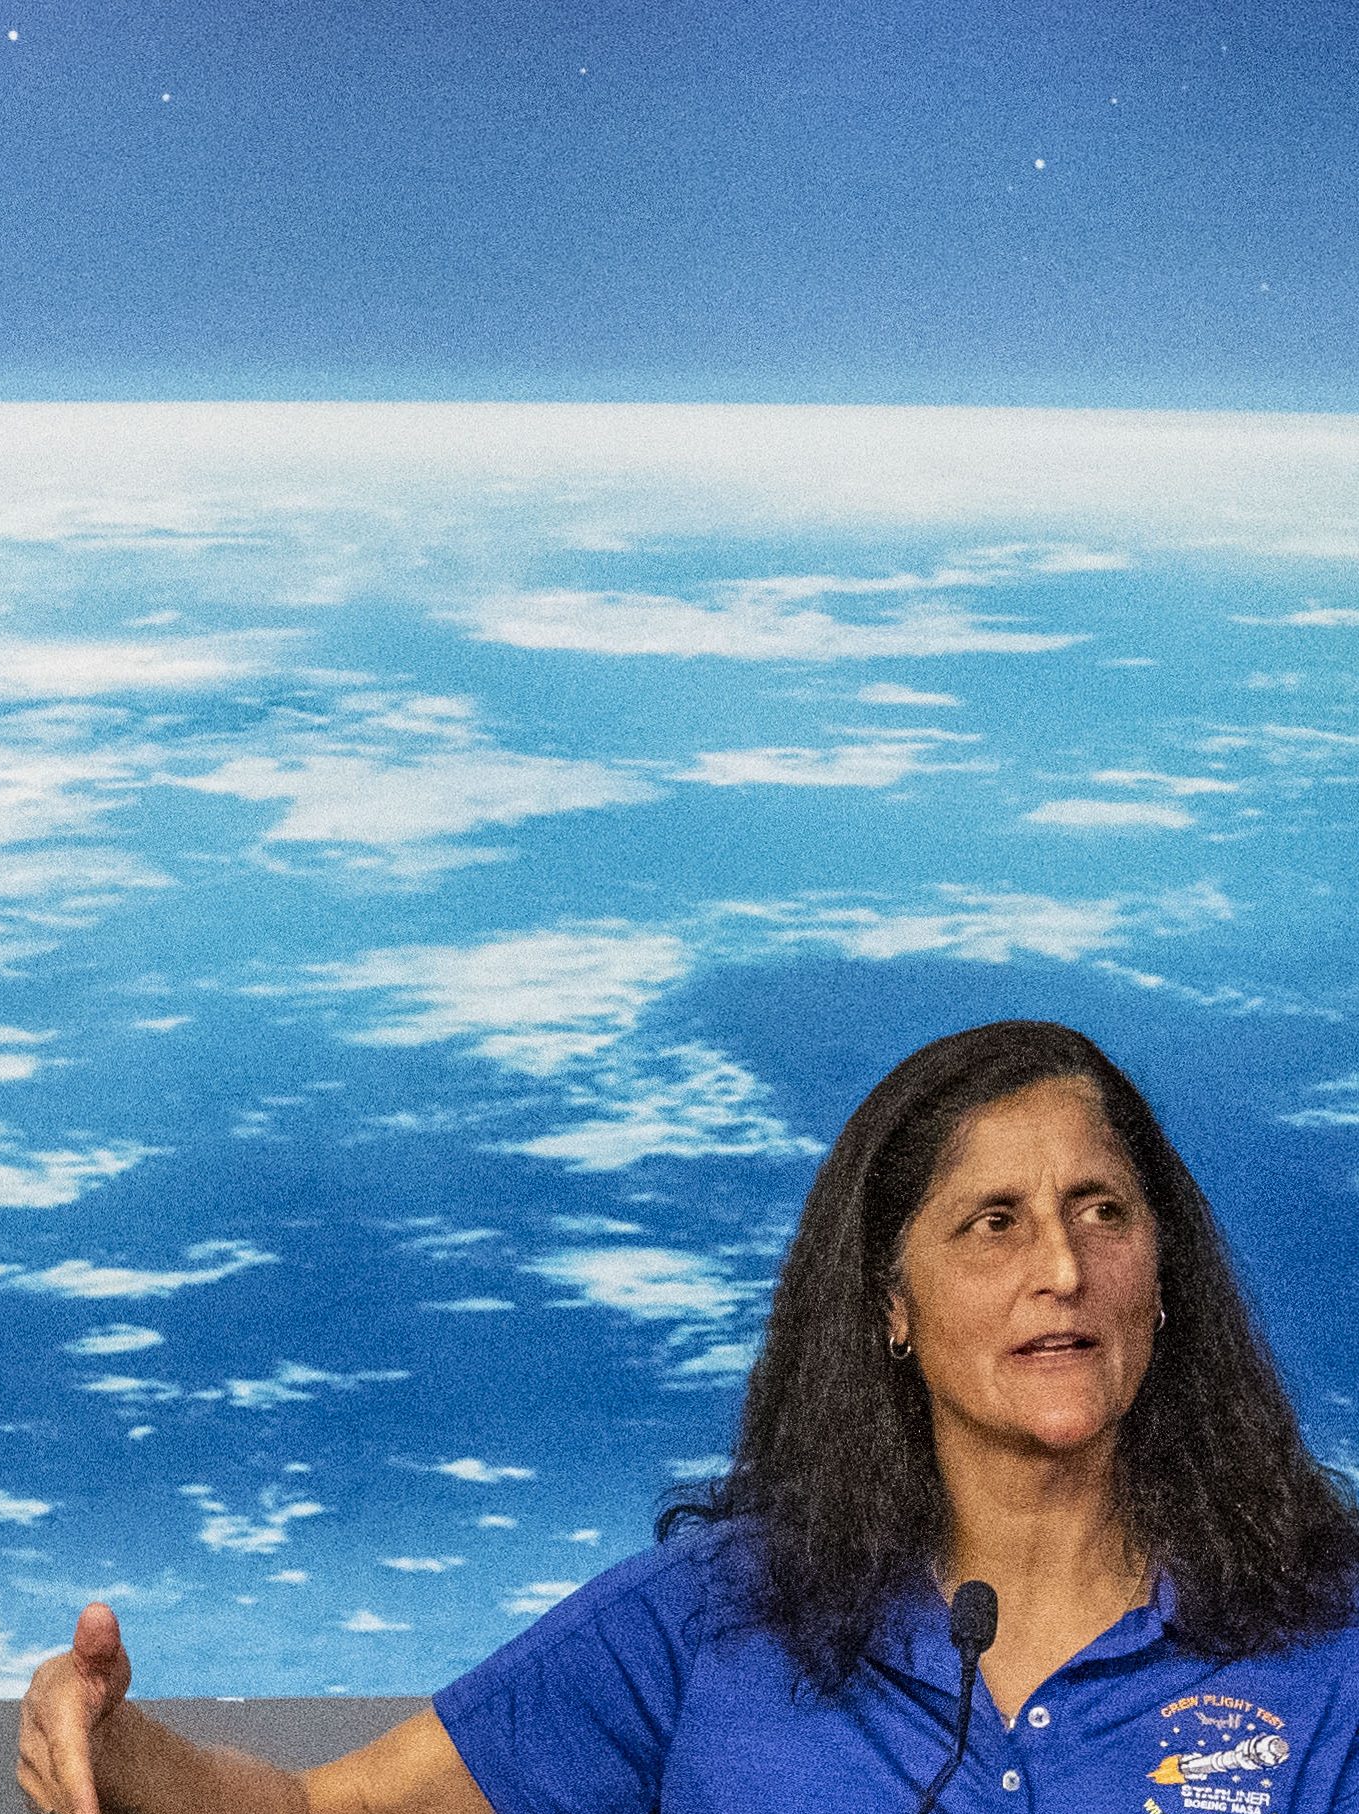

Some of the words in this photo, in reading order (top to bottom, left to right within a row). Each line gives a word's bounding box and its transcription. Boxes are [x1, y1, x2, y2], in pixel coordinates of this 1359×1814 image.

[1160, 1696, 1198, 1718] CREW
[1203, 1695, 1253, 1713] FLIGHT
[1256, 1707, 1286, 1730] TEST
[1180, 1784, 1271, 1806] STARLINER
[1184, 1799, 1227, 1812] BOEING
